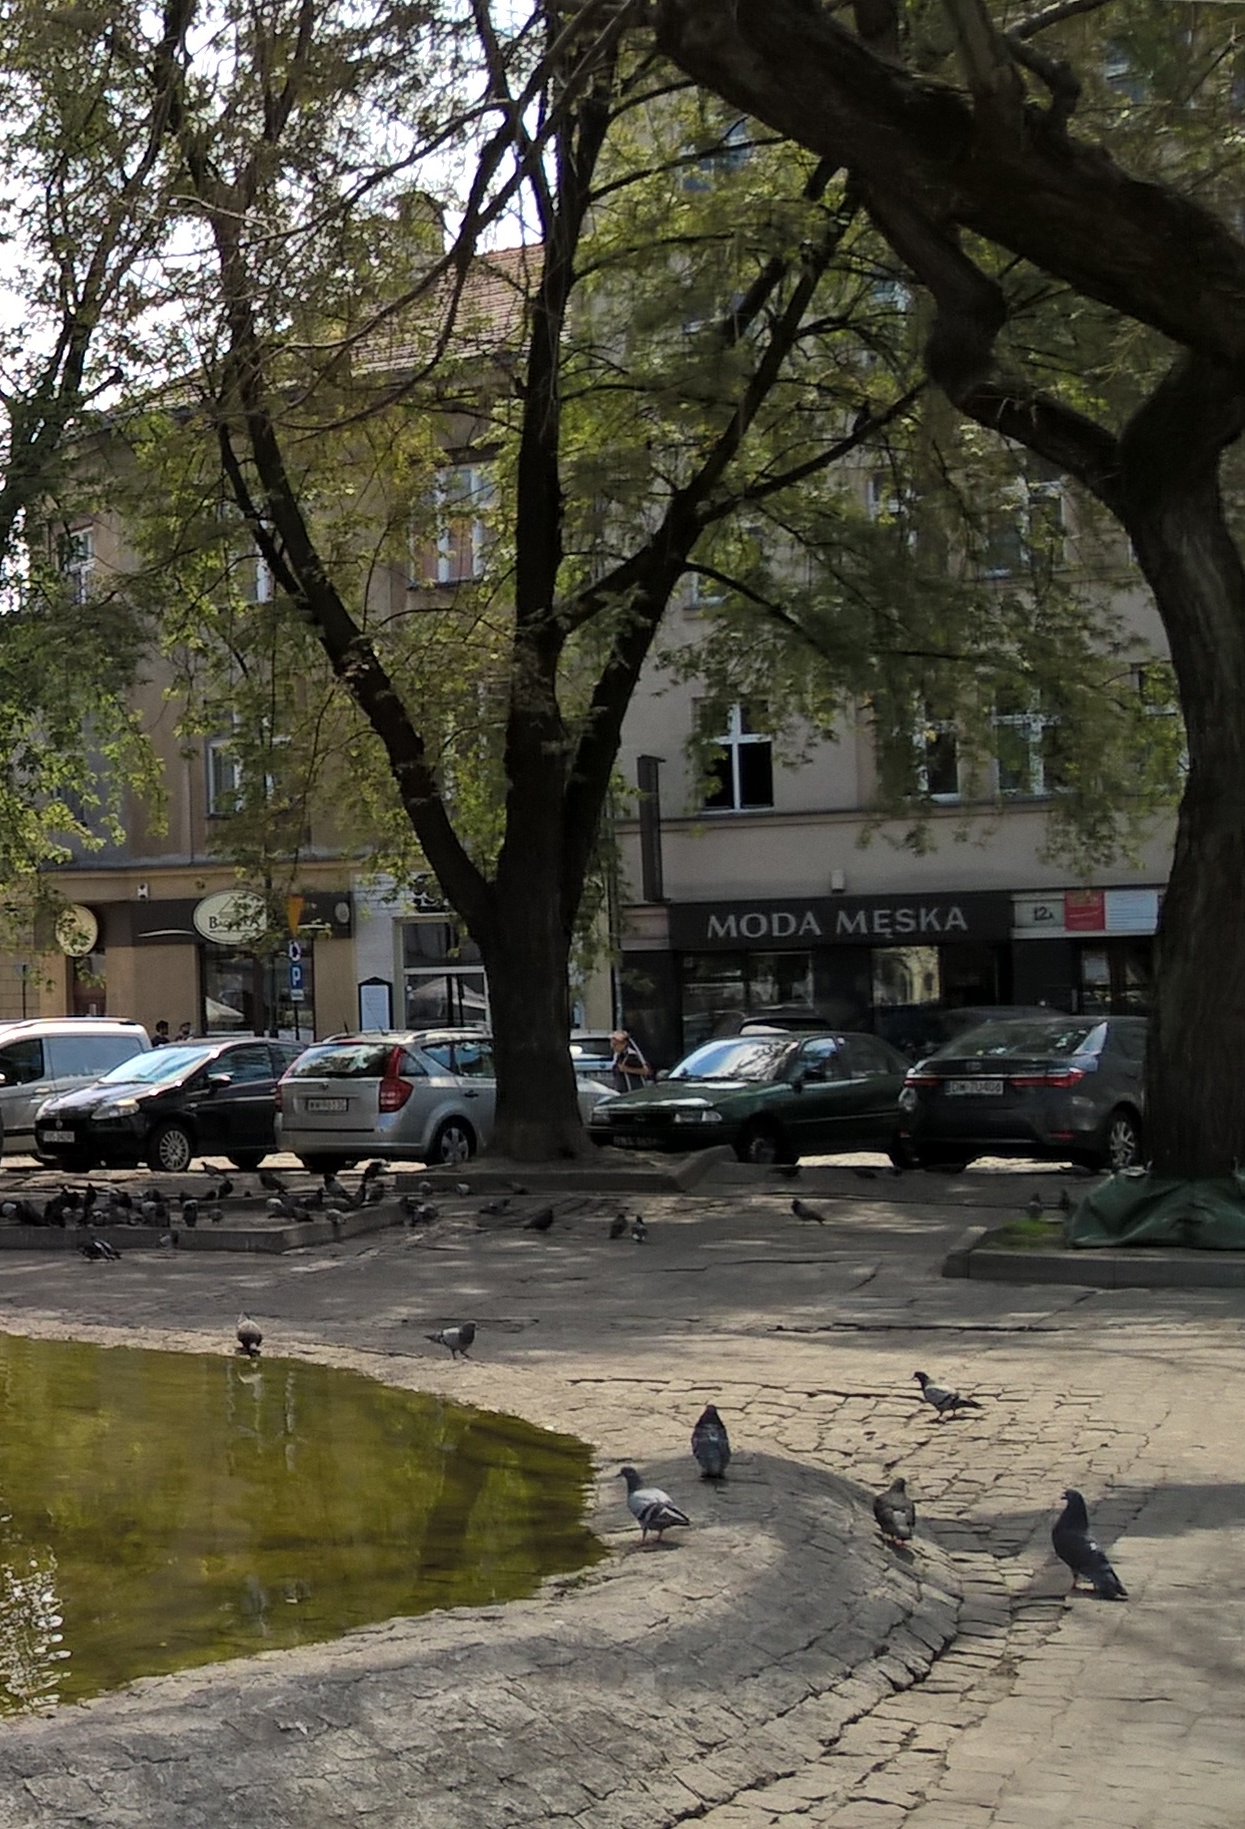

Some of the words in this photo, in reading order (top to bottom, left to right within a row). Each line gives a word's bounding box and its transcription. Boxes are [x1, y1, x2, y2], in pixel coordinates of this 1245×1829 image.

[707, 911, 823, 939] MODA
[835, 906, 968, 939] MĘSKA
[292, 966, 301, 986] P
